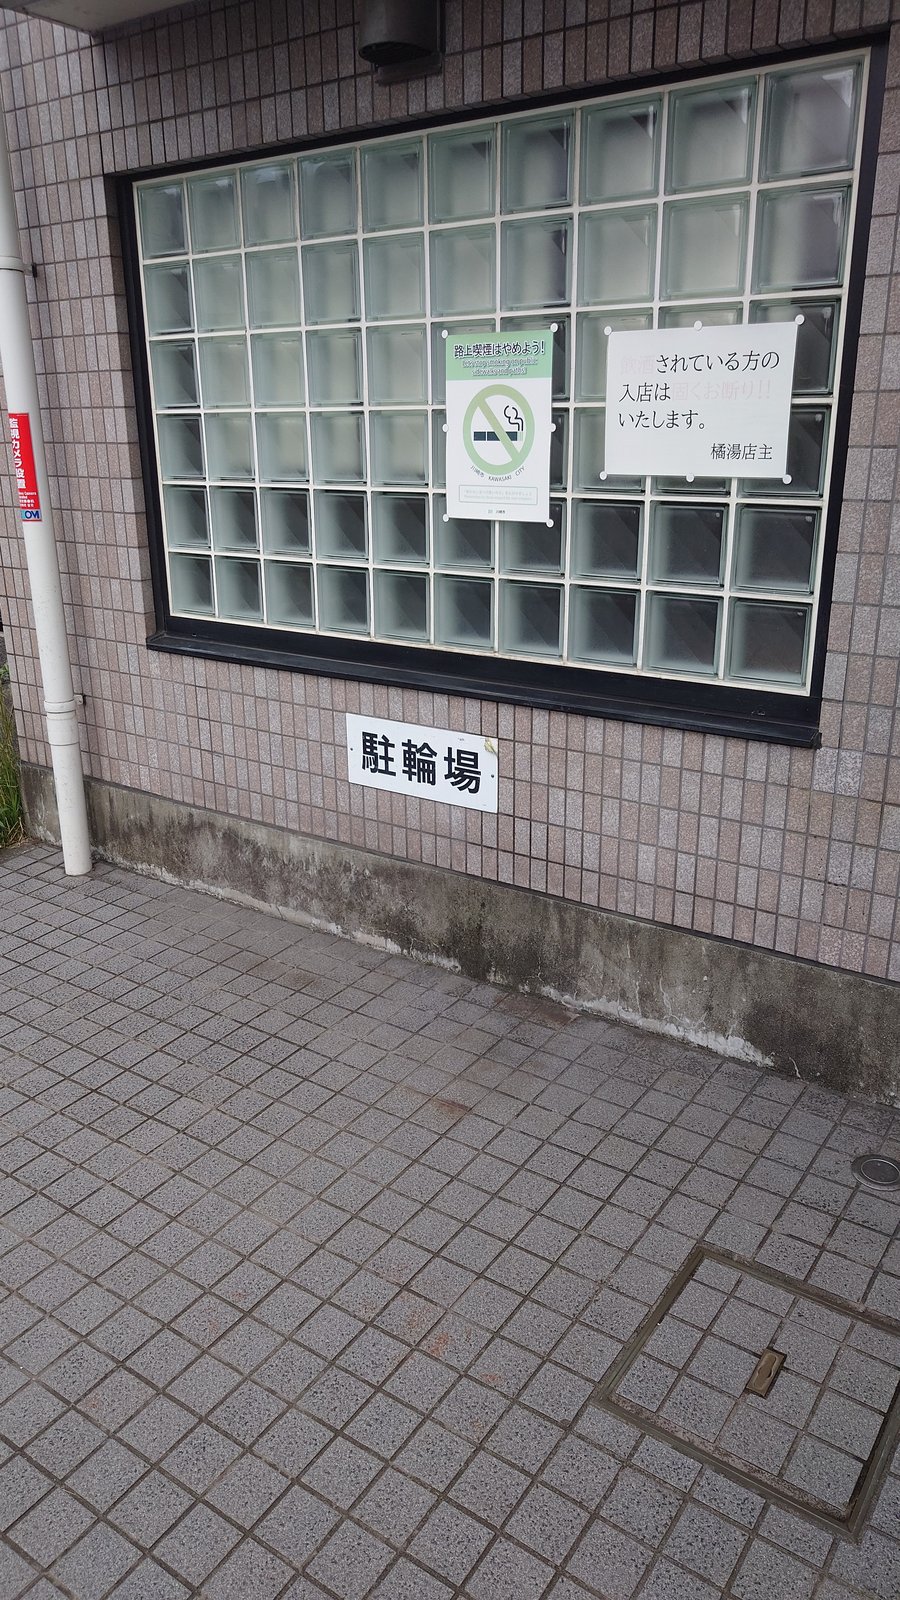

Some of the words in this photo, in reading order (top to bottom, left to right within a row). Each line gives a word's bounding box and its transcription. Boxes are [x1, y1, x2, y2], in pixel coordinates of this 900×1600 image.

[454, 340, 545, 358] 路上喫煙はやめよう!
[618, 409, 705, 430] いたします。
[710, 442, 773, 461] 橘湯店主
[515, 465, 525, 476] CITY
[361, 731, 482, 795] 駐輪場
